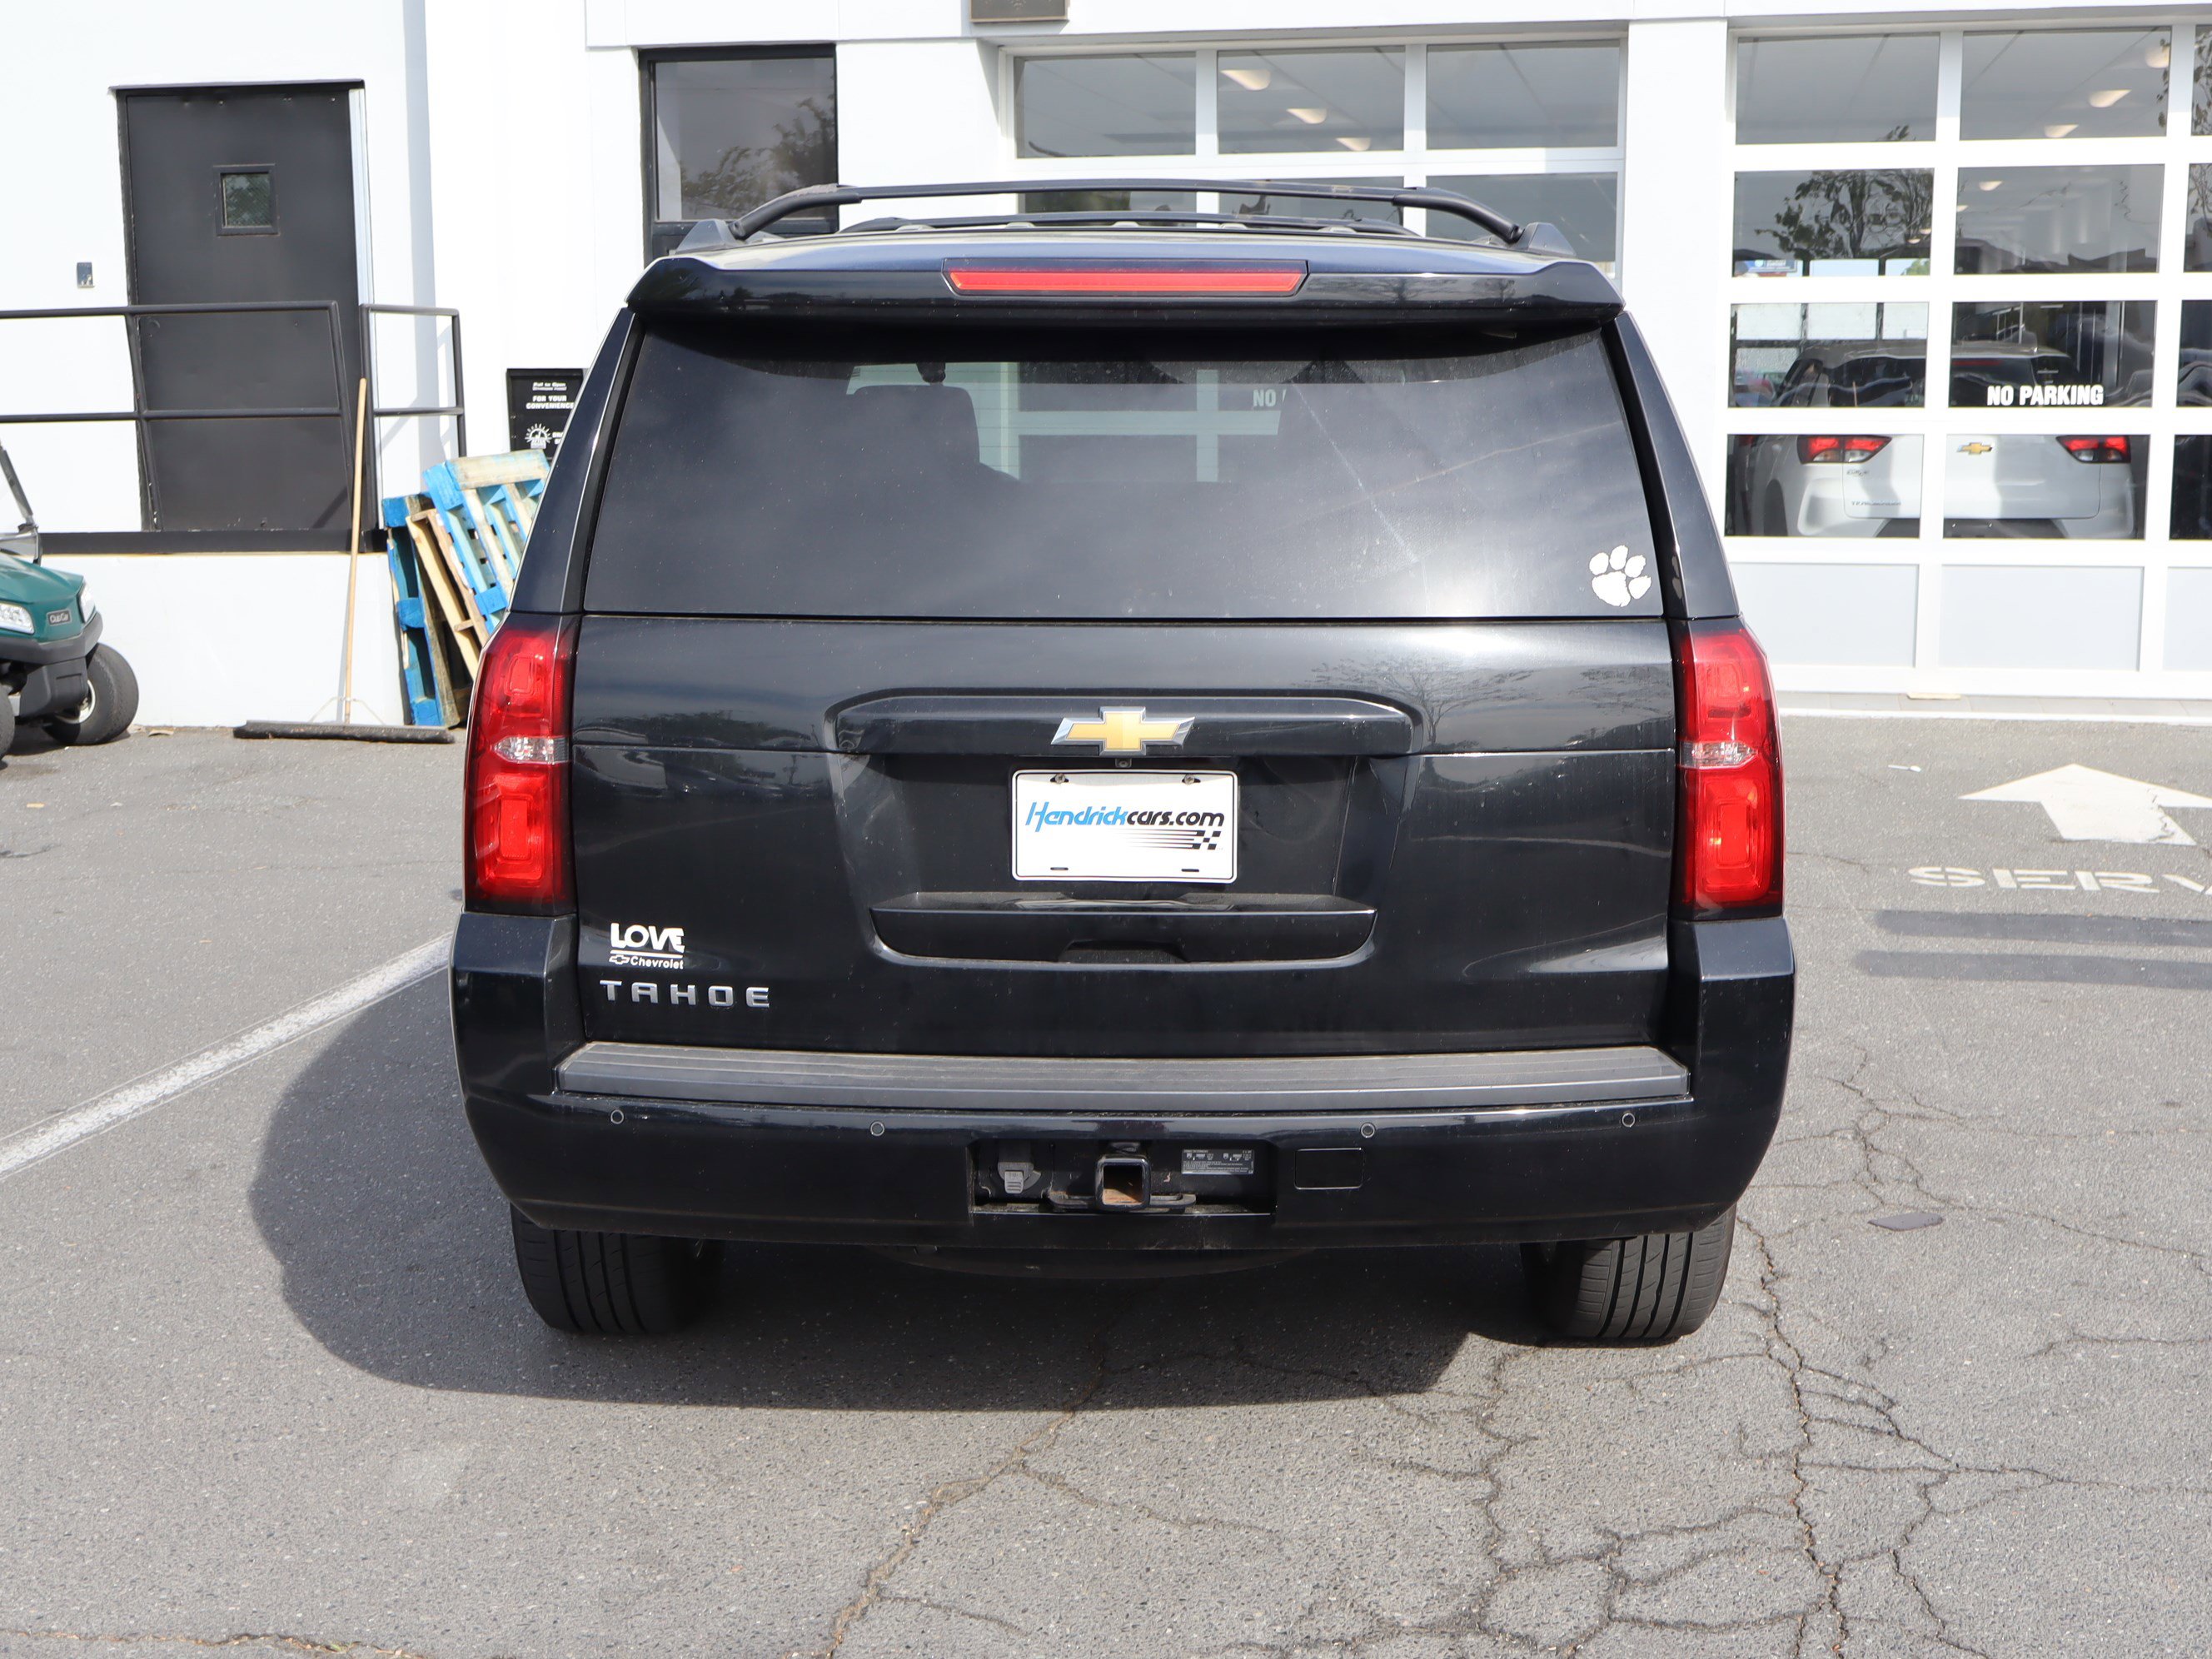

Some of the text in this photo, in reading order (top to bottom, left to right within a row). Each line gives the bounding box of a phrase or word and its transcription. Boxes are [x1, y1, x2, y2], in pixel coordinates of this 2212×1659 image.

[1253, 389, 1276, 407] NO
[1987, 384, 2104, 406] NO PARKING
[610, 923, 685, 954] LOVE
[630, 956, 684, 969] Chevrolet
[600, 979, 770, 1009] TAHOE
